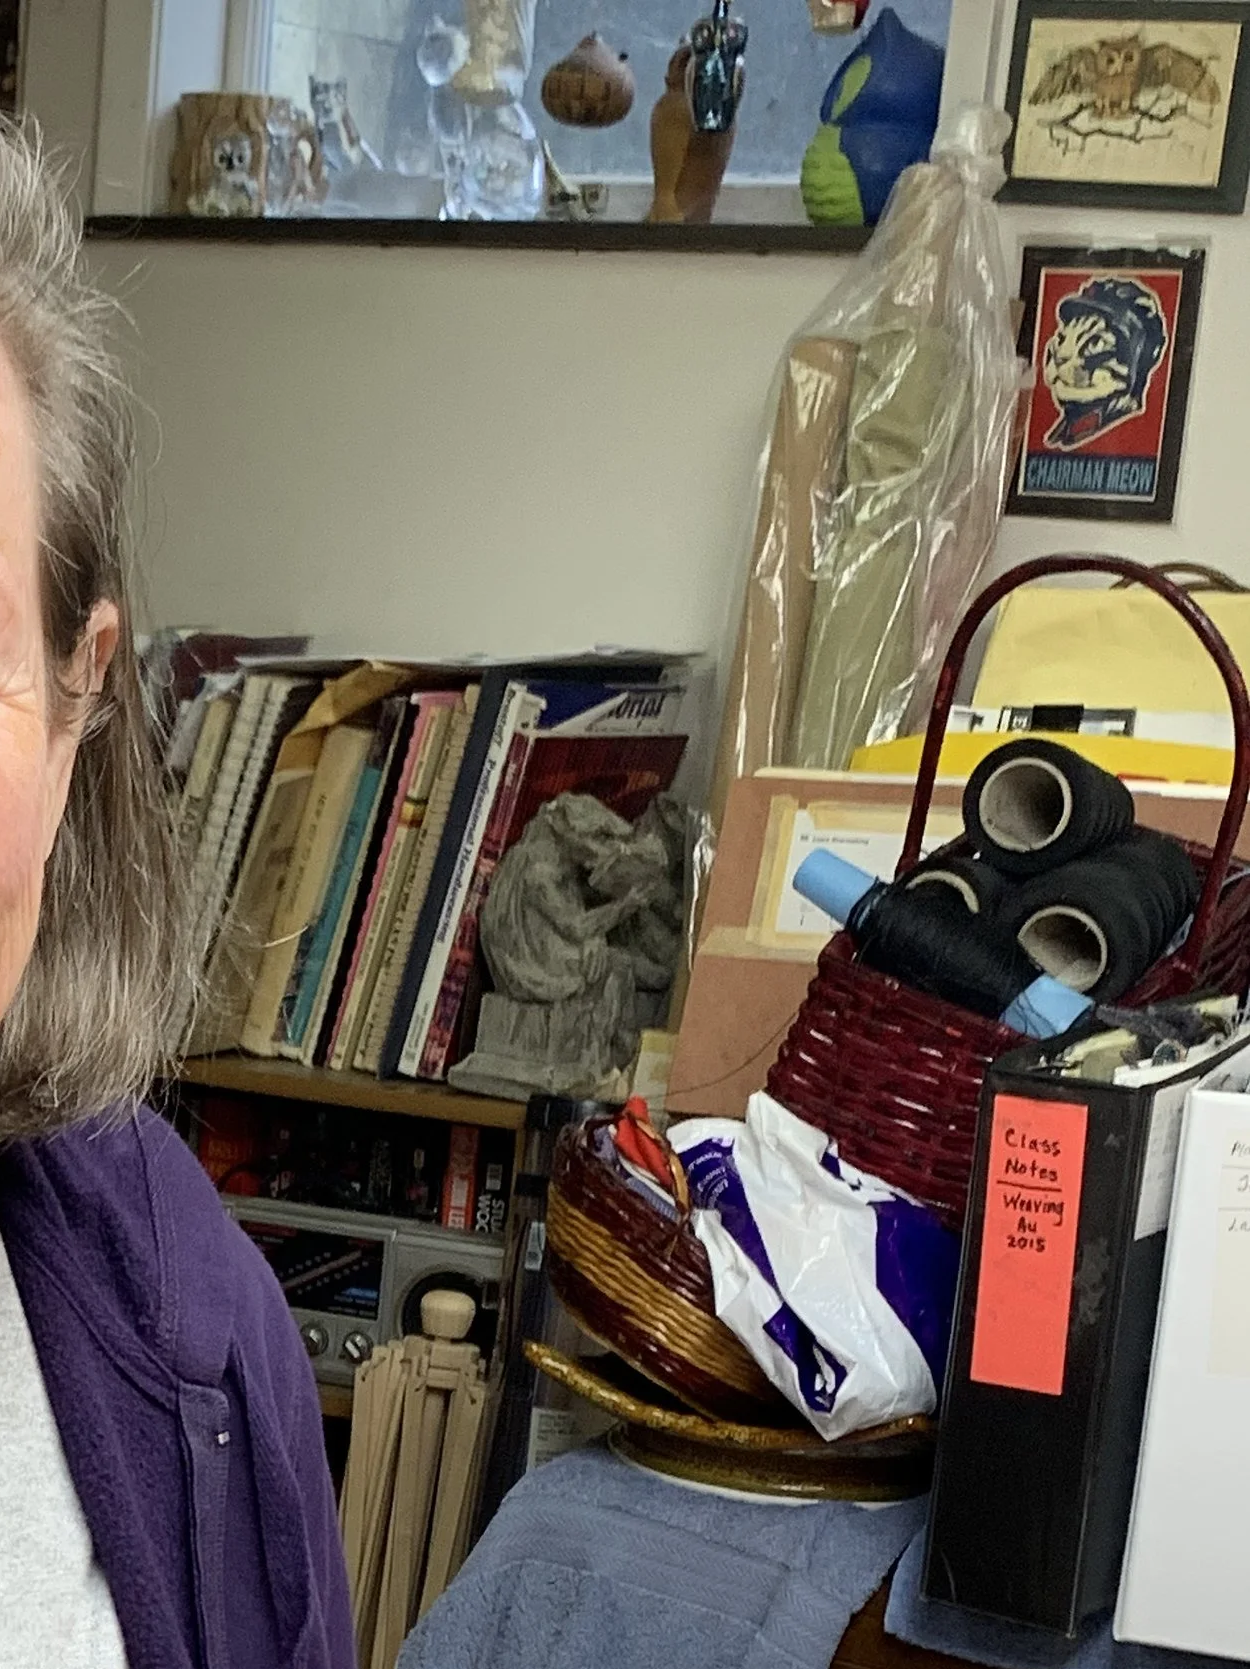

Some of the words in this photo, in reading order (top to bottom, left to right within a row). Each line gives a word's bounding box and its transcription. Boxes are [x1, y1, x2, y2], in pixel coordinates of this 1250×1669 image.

[1026, 456, 1105, 490] CHAIRMAN
[1107, 458, 1154, 493] MEOW
[1005, 1128, 1061, 1157] Class
[1004, 1157, 1058, 1182] Notes
[1003, 1191, 1065, 1227] Weaving
[1017, 1216, 1038, 1234] Au
[1006, 1234, 1046, 1253] 2015
